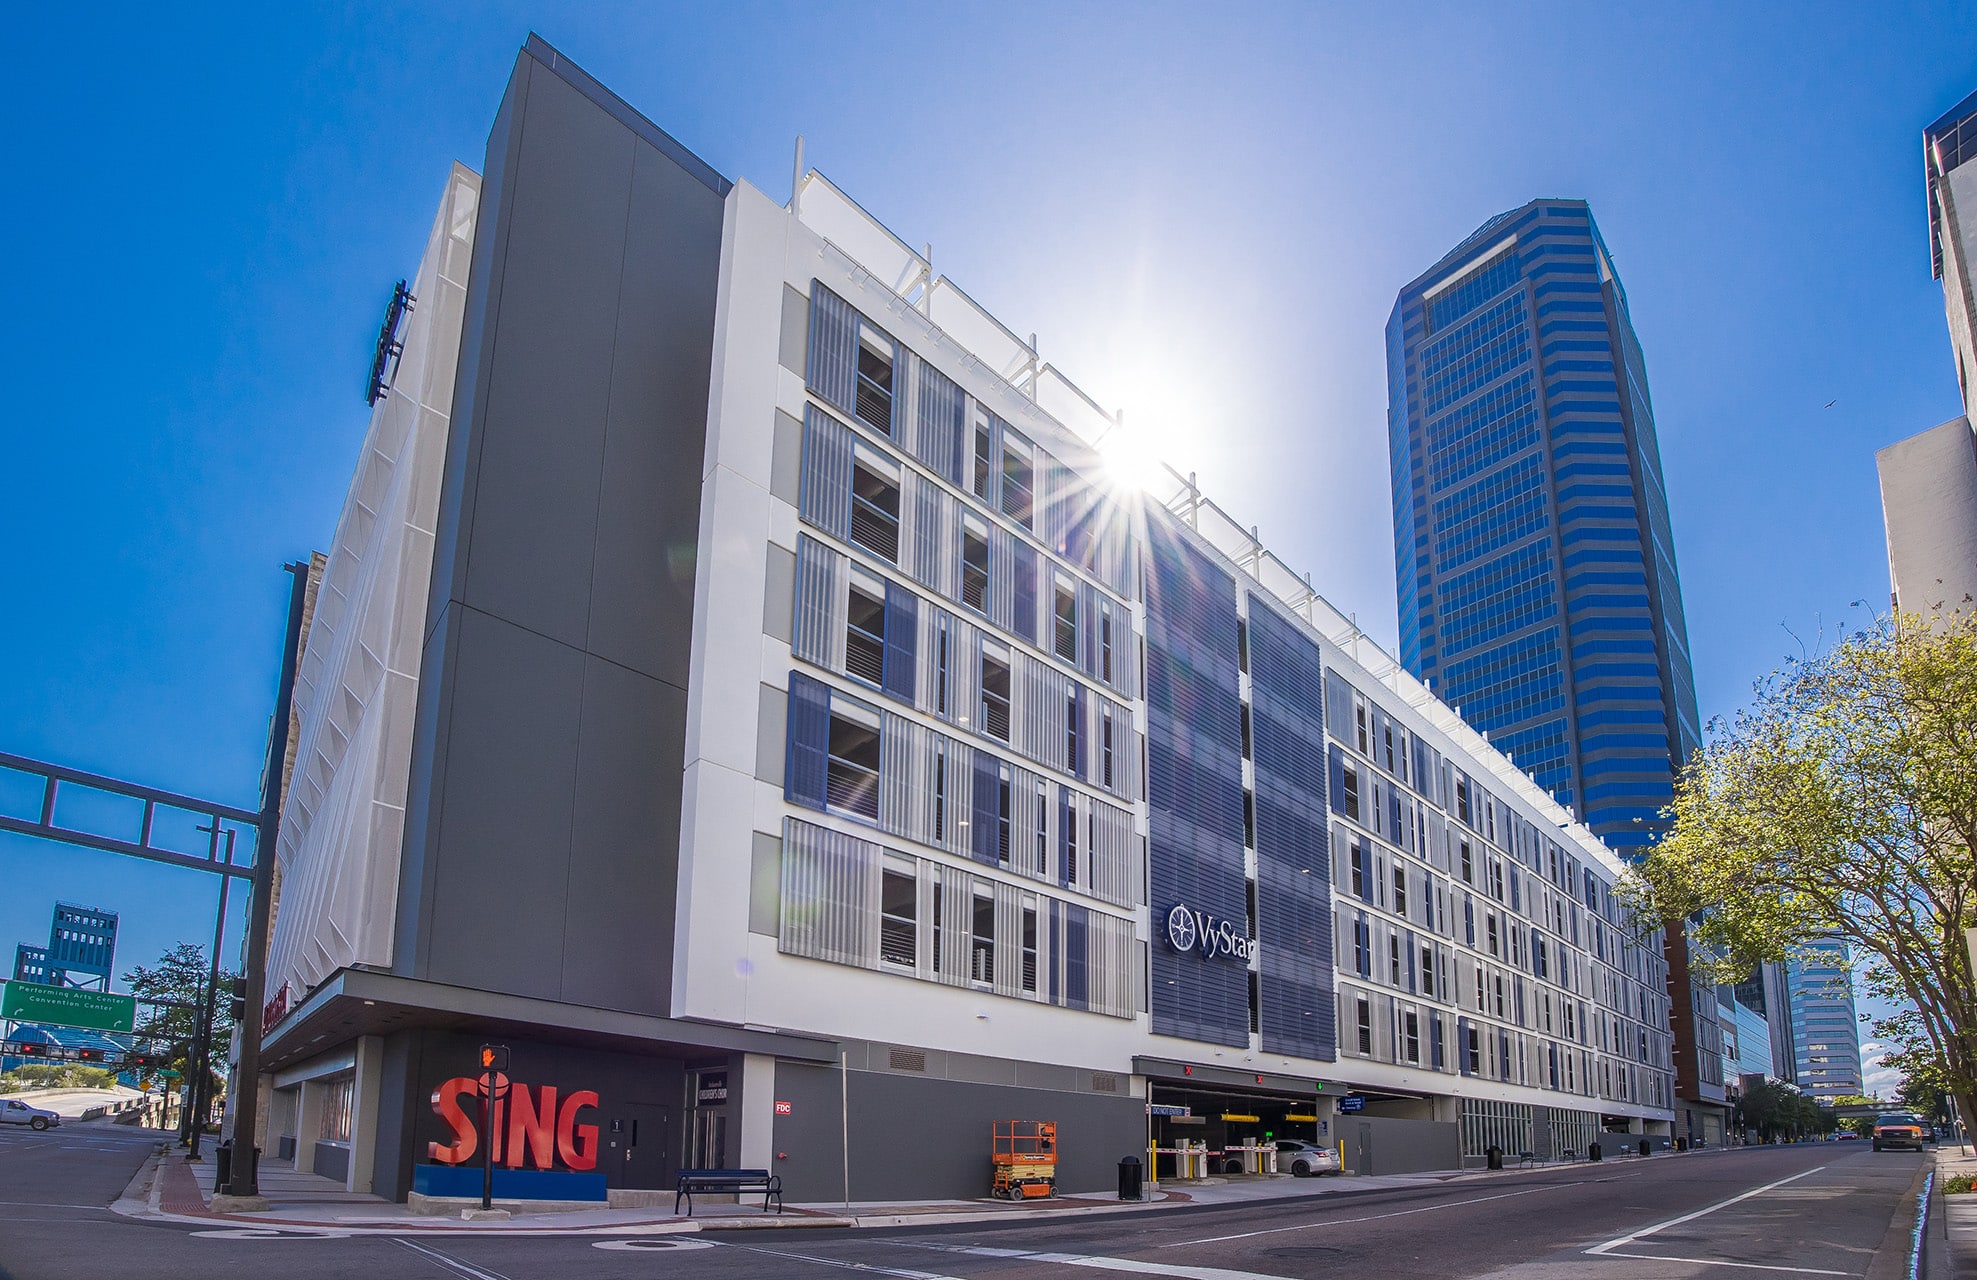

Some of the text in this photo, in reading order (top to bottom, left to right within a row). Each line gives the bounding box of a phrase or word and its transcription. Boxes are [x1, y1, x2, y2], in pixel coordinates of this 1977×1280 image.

[1194, 910, 1257, 960] VyStar
[18, 985, 125, 1005] Performing Arts Center
[29, 995, 113, 1012] Convention Center
[776, 1104, 791, 1112] FDC
[1159, 1107, 1169, 1115] NOT
[1169, 1108, 1182, 1116] ENTER
